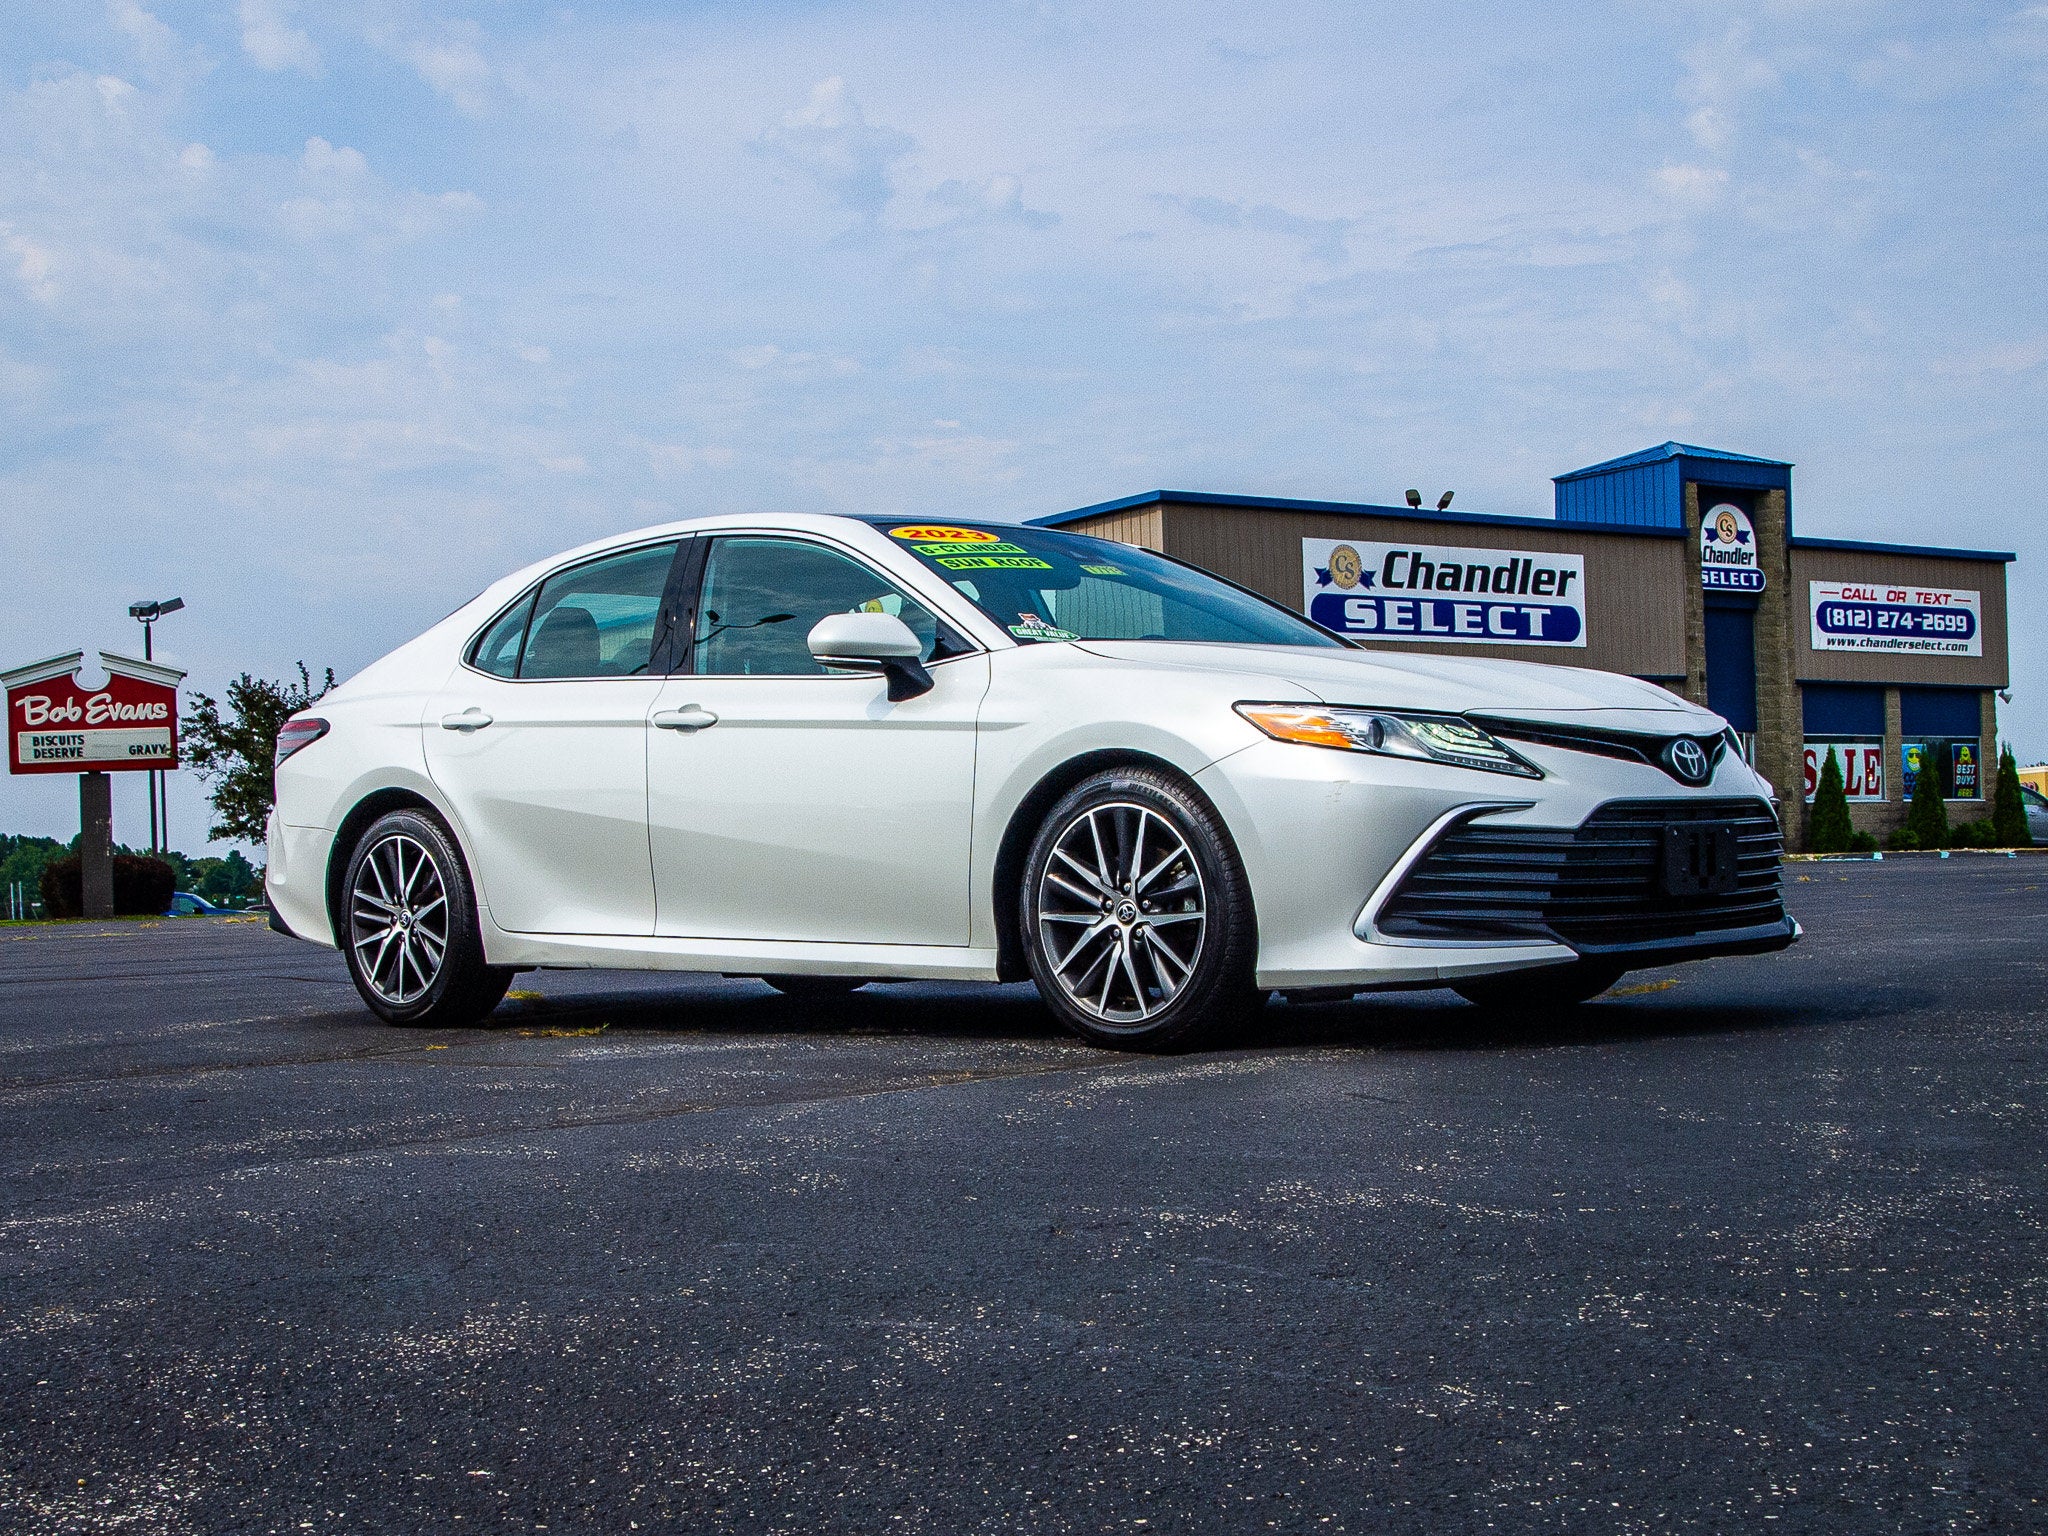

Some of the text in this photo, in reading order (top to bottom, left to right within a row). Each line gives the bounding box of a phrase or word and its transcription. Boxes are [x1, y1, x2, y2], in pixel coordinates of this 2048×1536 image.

[903, 529, 990, 541] 2023
[919, 543, 1019, 554] 6-CYLINDER
[1702, 545, 1754, 565] Chandler
[944, 557, 1046, 568] SUN ROOF
[1381, 550, 1577, 597] Chandler
[1702, 570, 1760, 587] SELECT
[1841, 587, 1952, 605] CALL OR TEXT
[1344, 598, 1551, 637] SELECT
[1826, 607, 1967, 632] (812) 274-2699
[1015, 628, 1043, 636] GREAT
[1826, 636, 1968, 652] www.chandlerselect.com
[15, 693, 168, 725] Bob Evans
[32, 735, 85, 747] BISCUITS
[33, 744, 166, 759] DESERVE GRAVY
[1804, 749, 1880, 796] SLE
[1956, 764, 1976, 774] BEST
[1955, 775, 1976, 785] BUYS
